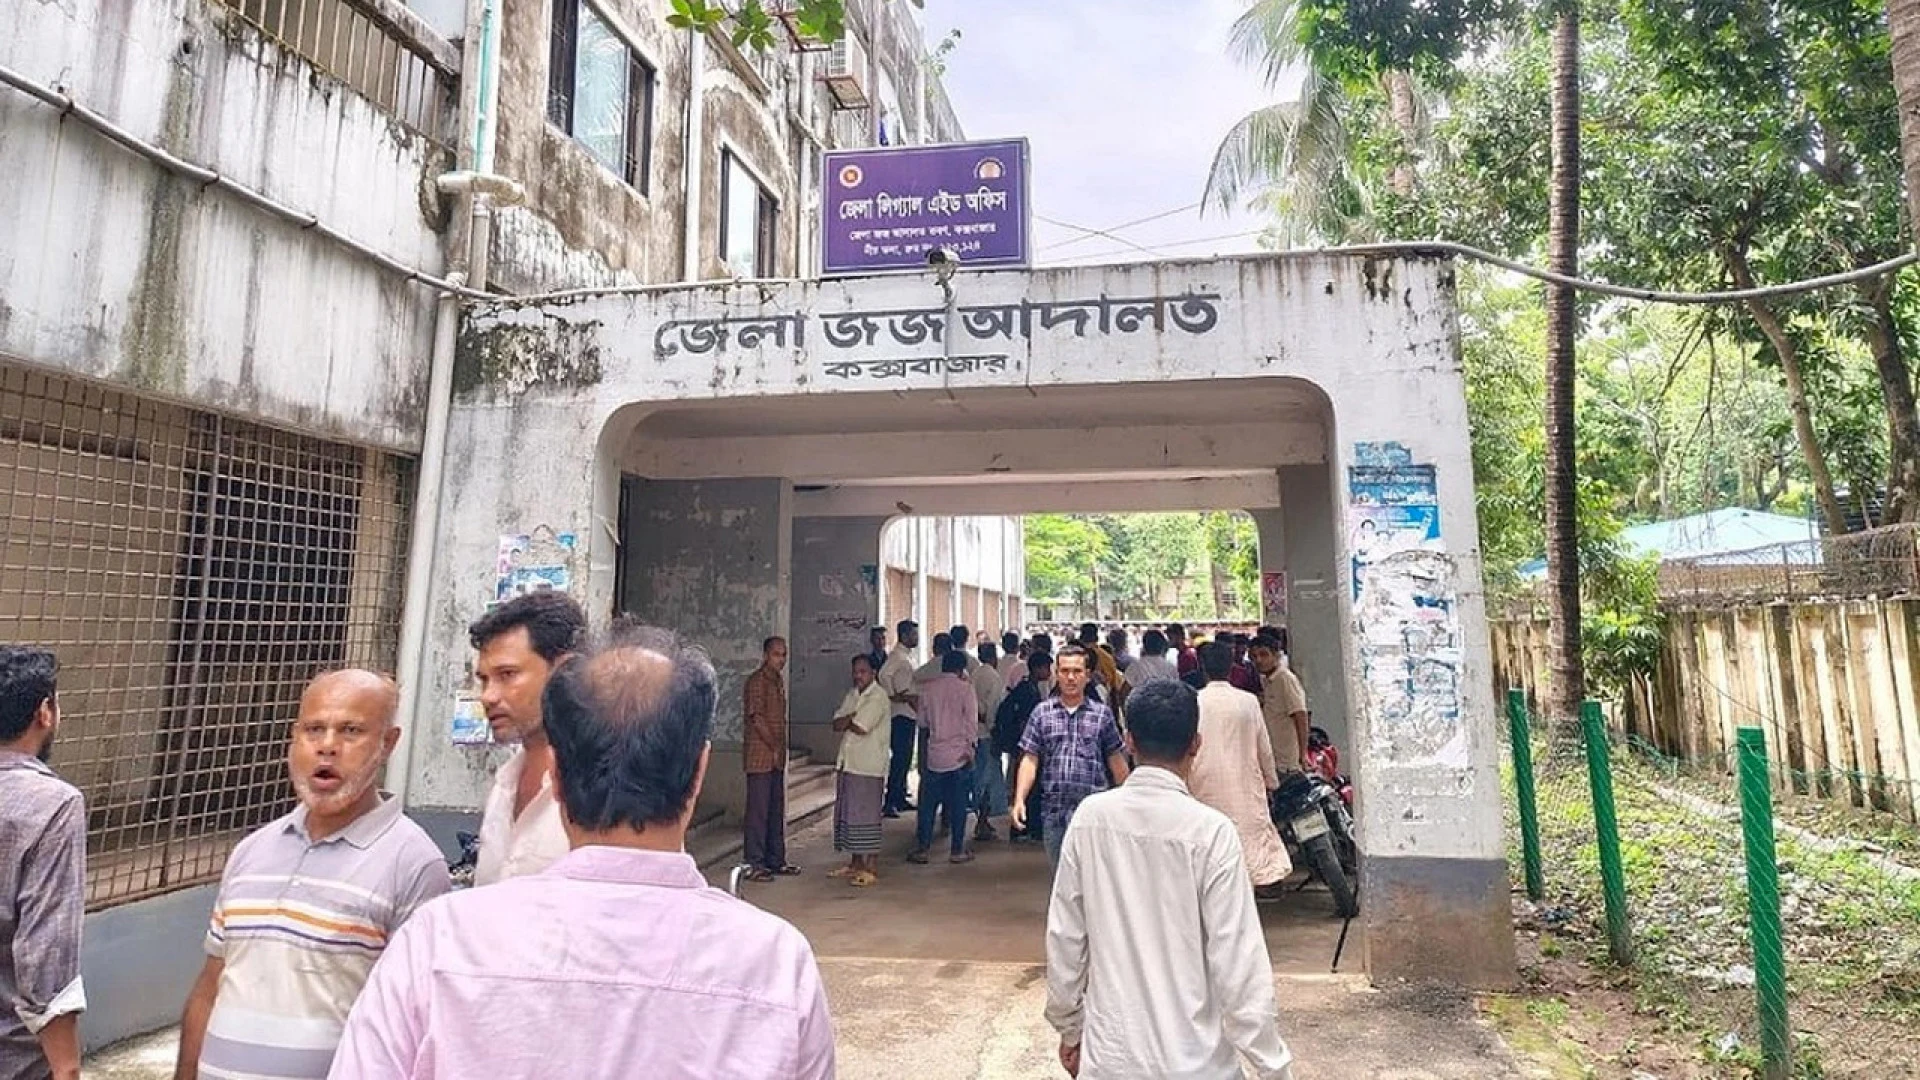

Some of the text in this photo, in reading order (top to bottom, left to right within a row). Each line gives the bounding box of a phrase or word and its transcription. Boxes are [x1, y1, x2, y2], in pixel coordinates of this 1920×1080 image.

[840, 185, 1007, 219] জেলা লিগ্যাল এইড অফিস
[653, 293, 1221, 355] জেলা জজ আদালত
